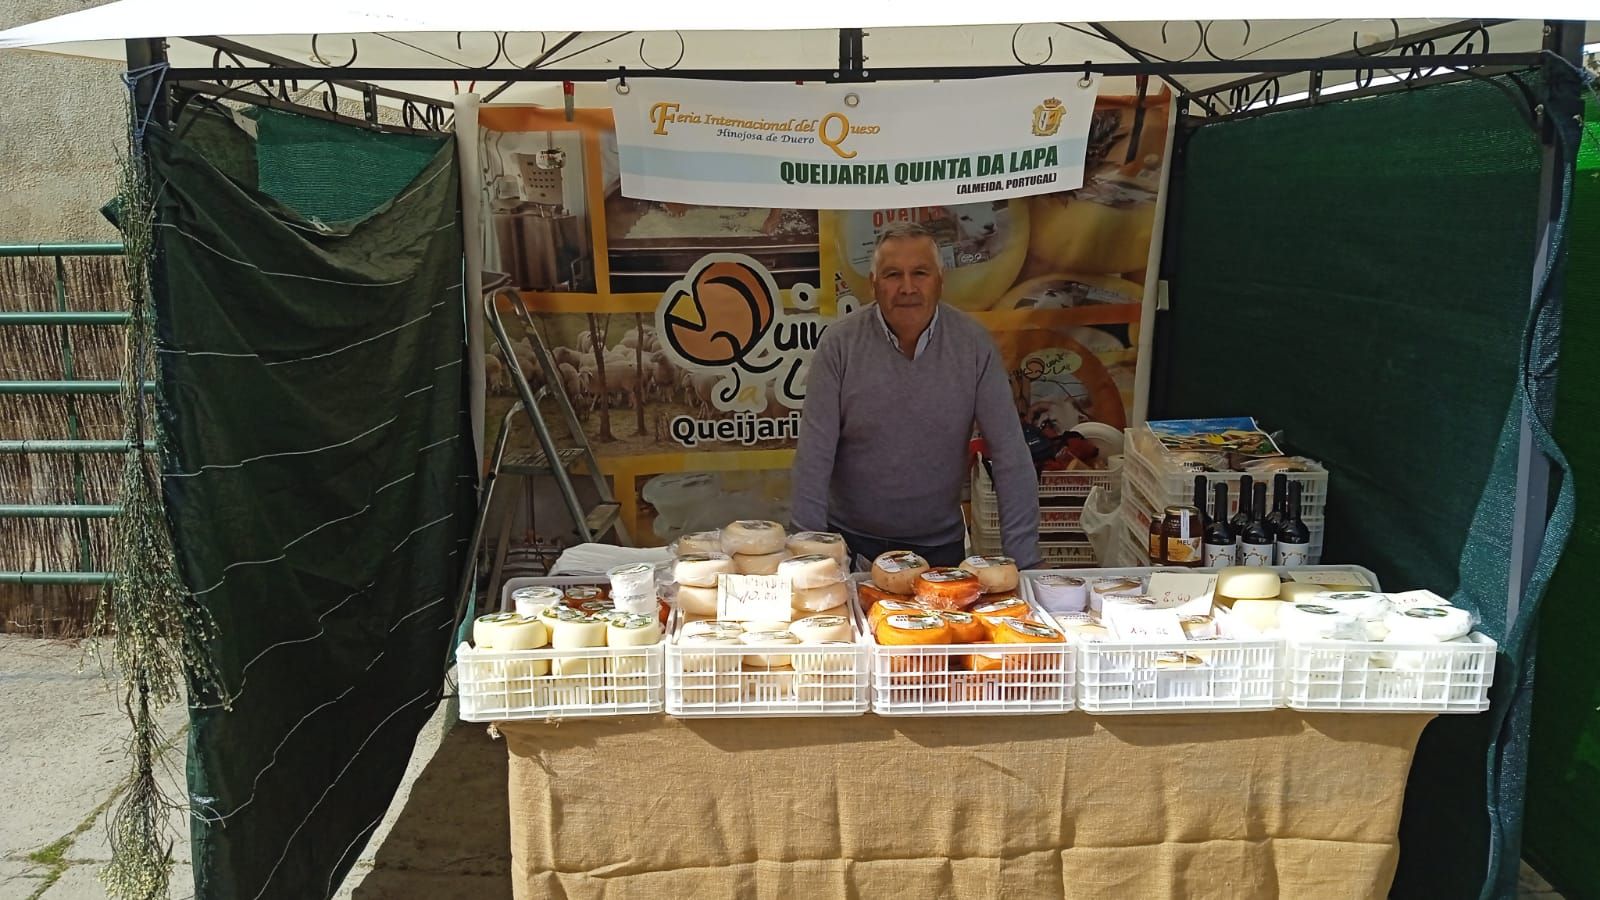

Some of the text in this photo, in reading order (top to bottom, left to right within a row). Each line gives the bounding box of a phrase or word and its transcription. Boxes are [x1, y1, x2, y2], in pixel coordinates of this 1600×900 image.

[650, 102, 881, 159] Feria Internacional del Queso
[716, 128, 815, 144] Hinojosa de Duero
[780, 145, 1059, 185] QUEIJARIA QUINTA DA LAPA
[1006, 172, 1057, 190] PORTUGAL)
[672, 412, 799, 444] Queijari
